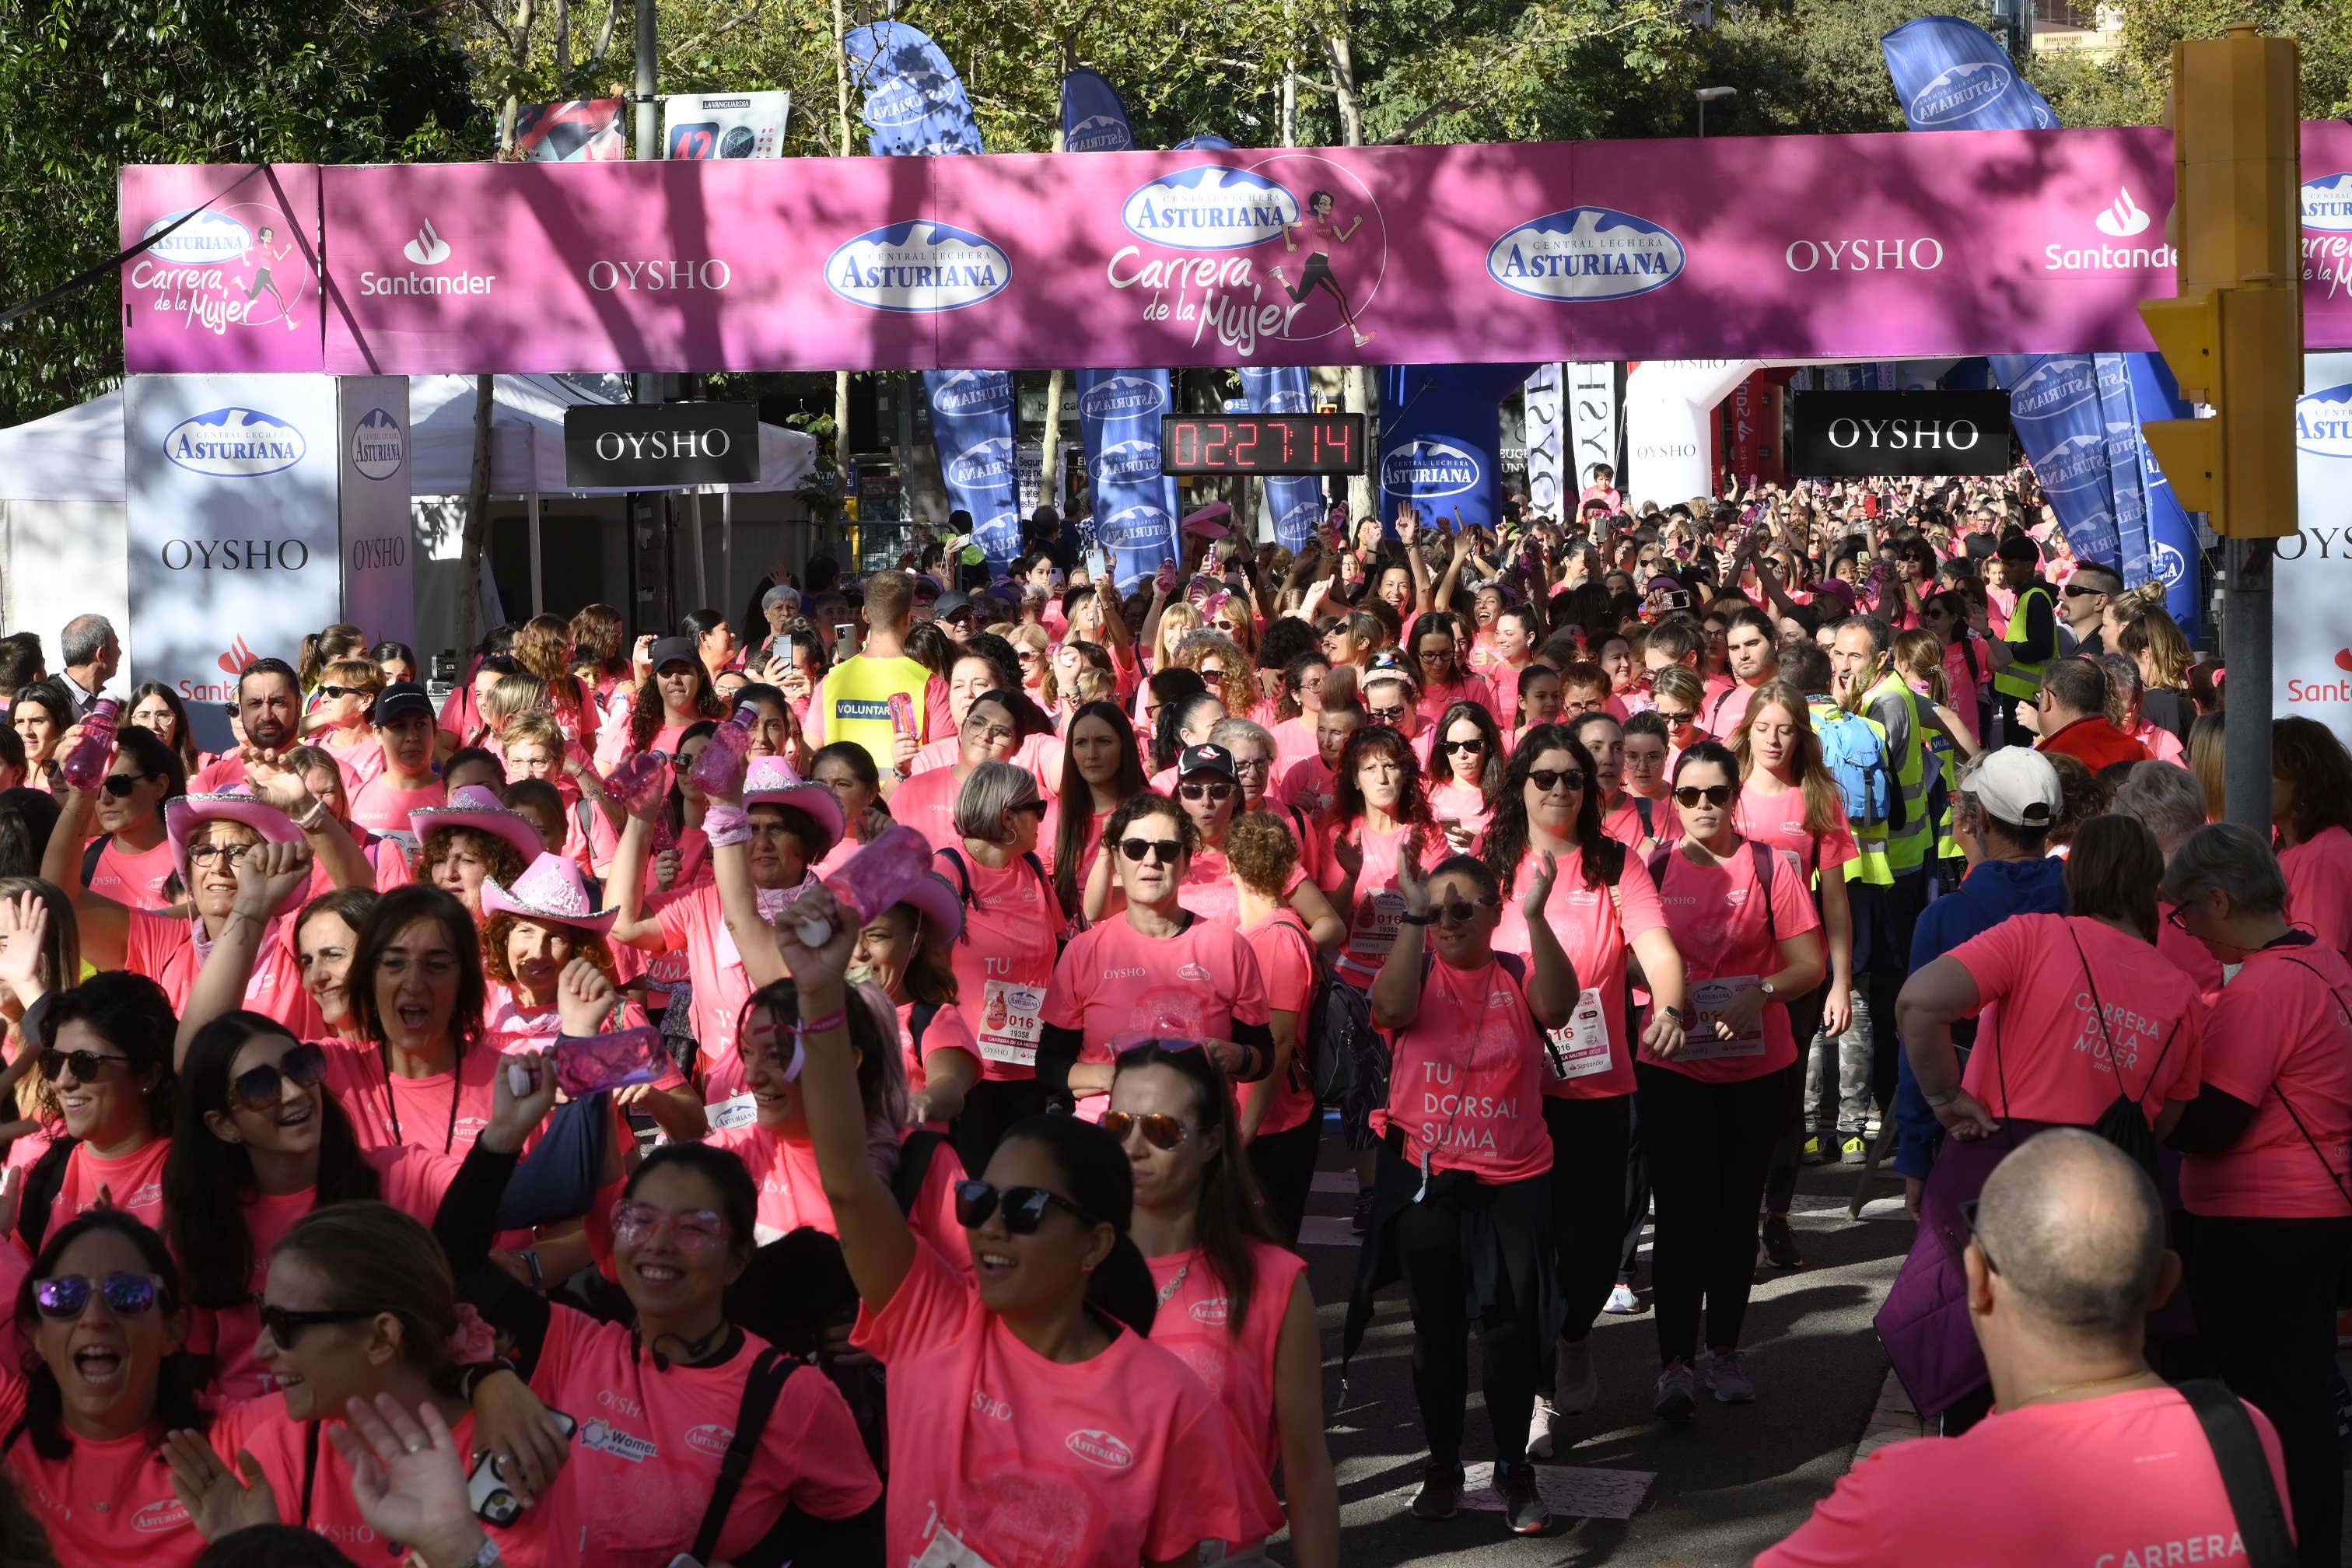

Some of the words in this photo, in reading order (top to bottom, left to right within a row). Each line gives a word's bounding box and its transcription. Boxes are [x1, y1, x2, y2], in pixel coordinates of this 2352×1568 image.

[711, 100, 750, 108] VANGUARDIA
[1136, 197, 1284, 229] ASTURIANA
[868, 251, 926, 261] CENTRAL
[932, 251, 991, 261] LECHERA
[1533, 240, 1594, 250] CENTRAL
[1600, 238, 1664, 248] LECHERA
[1785, 236, 1944, 272] OYSHO
[839, 254, 998, 288] ASTURIANA
[1107, 245, 1253, 289] Carrera
[1502, 243, 1670, 278] ASTURIANA
[131, 260, 223, 290] Carrera
[360, 271, 495, 296] Santander
[587, 259, 731, 292] OYSHO
[154, 290, 172, 312] de
[174, 288, 188, 312] la
[184, 287, 259, 337] Mujer
[1143, 291, 1170, 321] de
[1175, 289, 1195, 321] la
[1191, 284, 1307, 357] Mujer
[174, 433, 296, 460] ASTURIANA
[595, 428, 731, 461] OYSHO
[1174, 423, 1349, 467] 02:27:14
[1828, 418, 1980, 450] OYSHO
[355, 434, 401, 464] ASTURIANA
[1637, 443, 1696, 460] OYSHO
[1019, 470, 1032, 478] que
[1020, 479, 1044, 488] quiere
[1384, 464, 1472, 485] ASTURIANA
[161, 539, 309, 571] OYSHO
[354, 535, 404, 571] OYSHO
[1377, 914, 1402, 926] 016
[984, 957, 1011, 975] TU
[1103, 966, 1146, 981] OYSHO
[1010, 998, 1041, 1009] ASTURIANA
[2074, 992, 2159, 1040] CARRERA
[1008, 1014, 1034, 1029] 016
[1010, 1030, 1030, 1040] 19358
[2084, 1016, 2112, 1040] DE
[2115, 1027, 2138, 1052] LA
[984, 1046, 1009, 1058] OYSHO
[988, 1036, 1010, 1045] CARRERA
[2073, 1033, 2139, 1071] MUJER
[1569, 1052, 1587, 1060] MUJER
[1576, 1059, 1605, 1071] Santander
[1423, 1061, 1453, 1084] TU
[719, 1111, 756, 1127] ASTURIANA
[1424, 1092, 1518, 1119] DORSAL
[1422, 1122, 1496, 1149] SUMA
[1072, 1434, 1127, 1465] ASTURIANA
